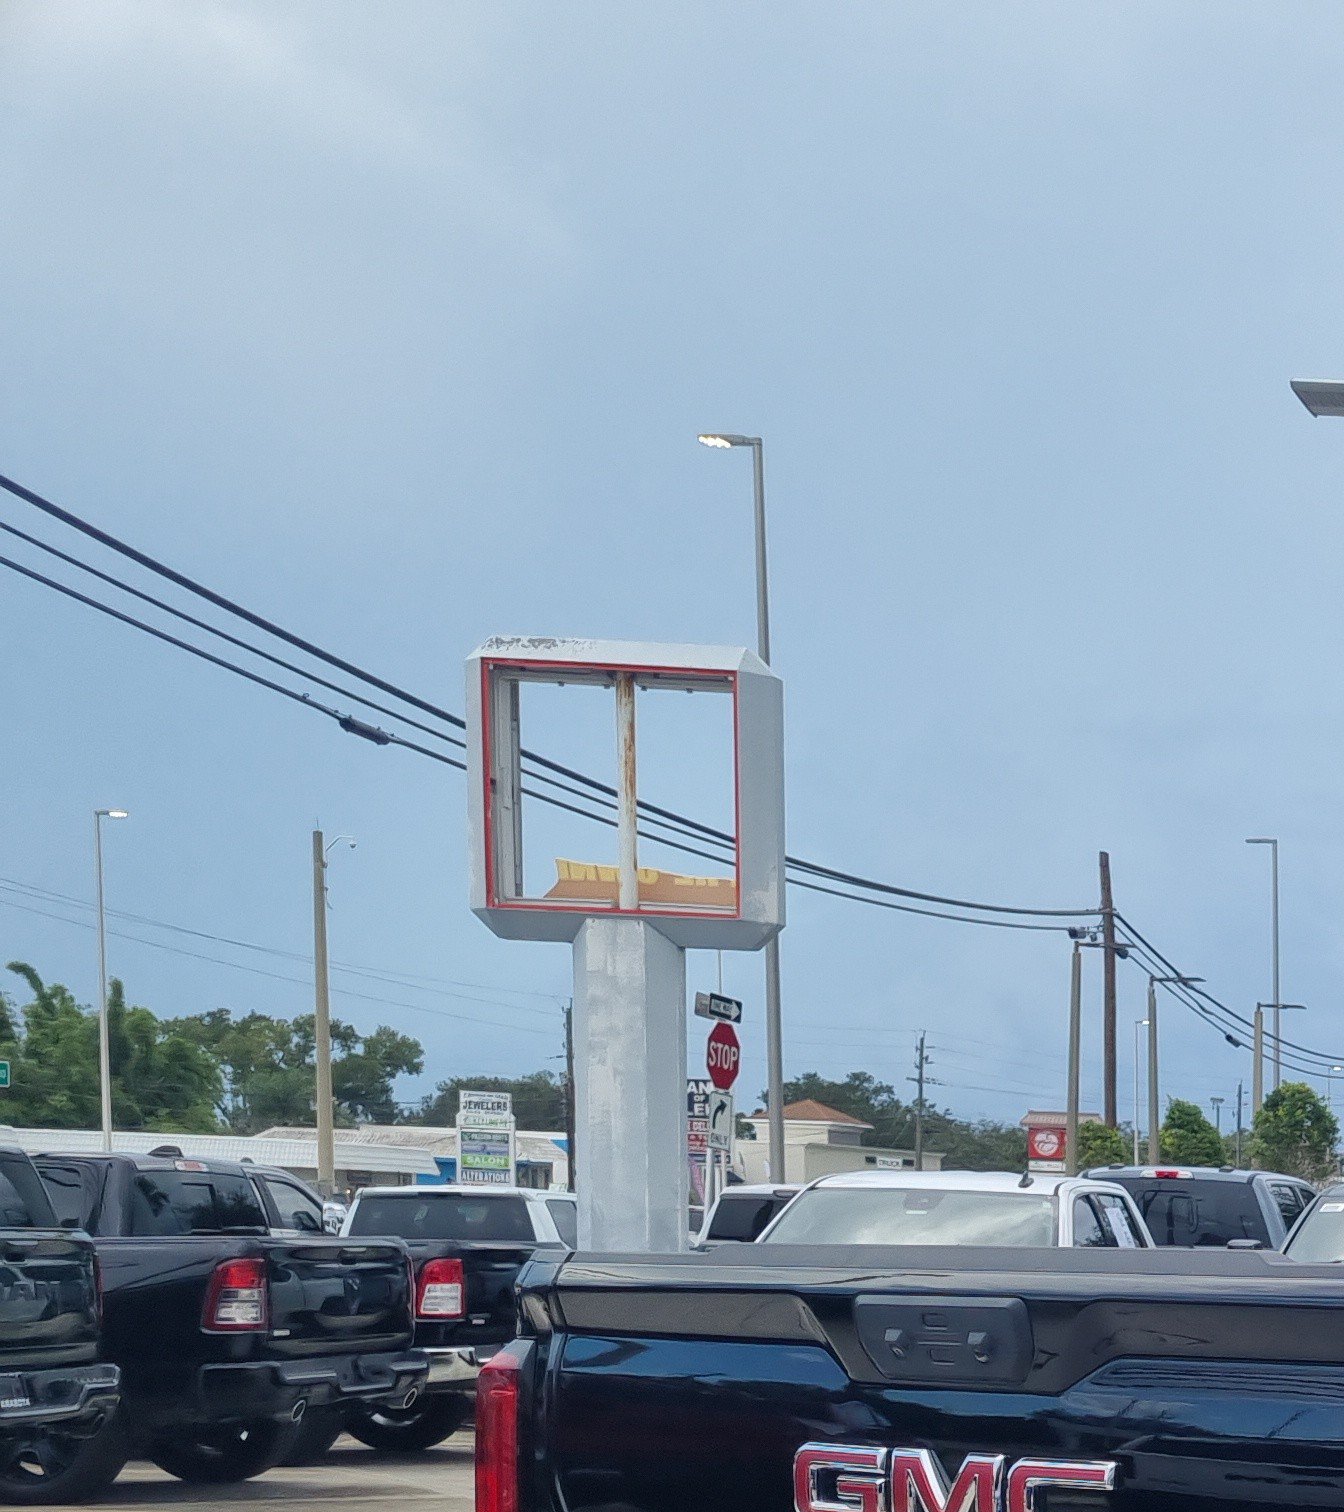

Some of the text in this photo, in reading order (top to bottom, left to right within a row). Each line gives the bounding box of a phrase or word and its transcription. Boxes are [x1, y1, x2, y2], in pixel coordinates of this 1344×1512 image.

[709, 1041, 738, 1070] STOP
[463, 1100, 508, 1111] JEWELERS
[467, 1156, 505, 1165] SALON
